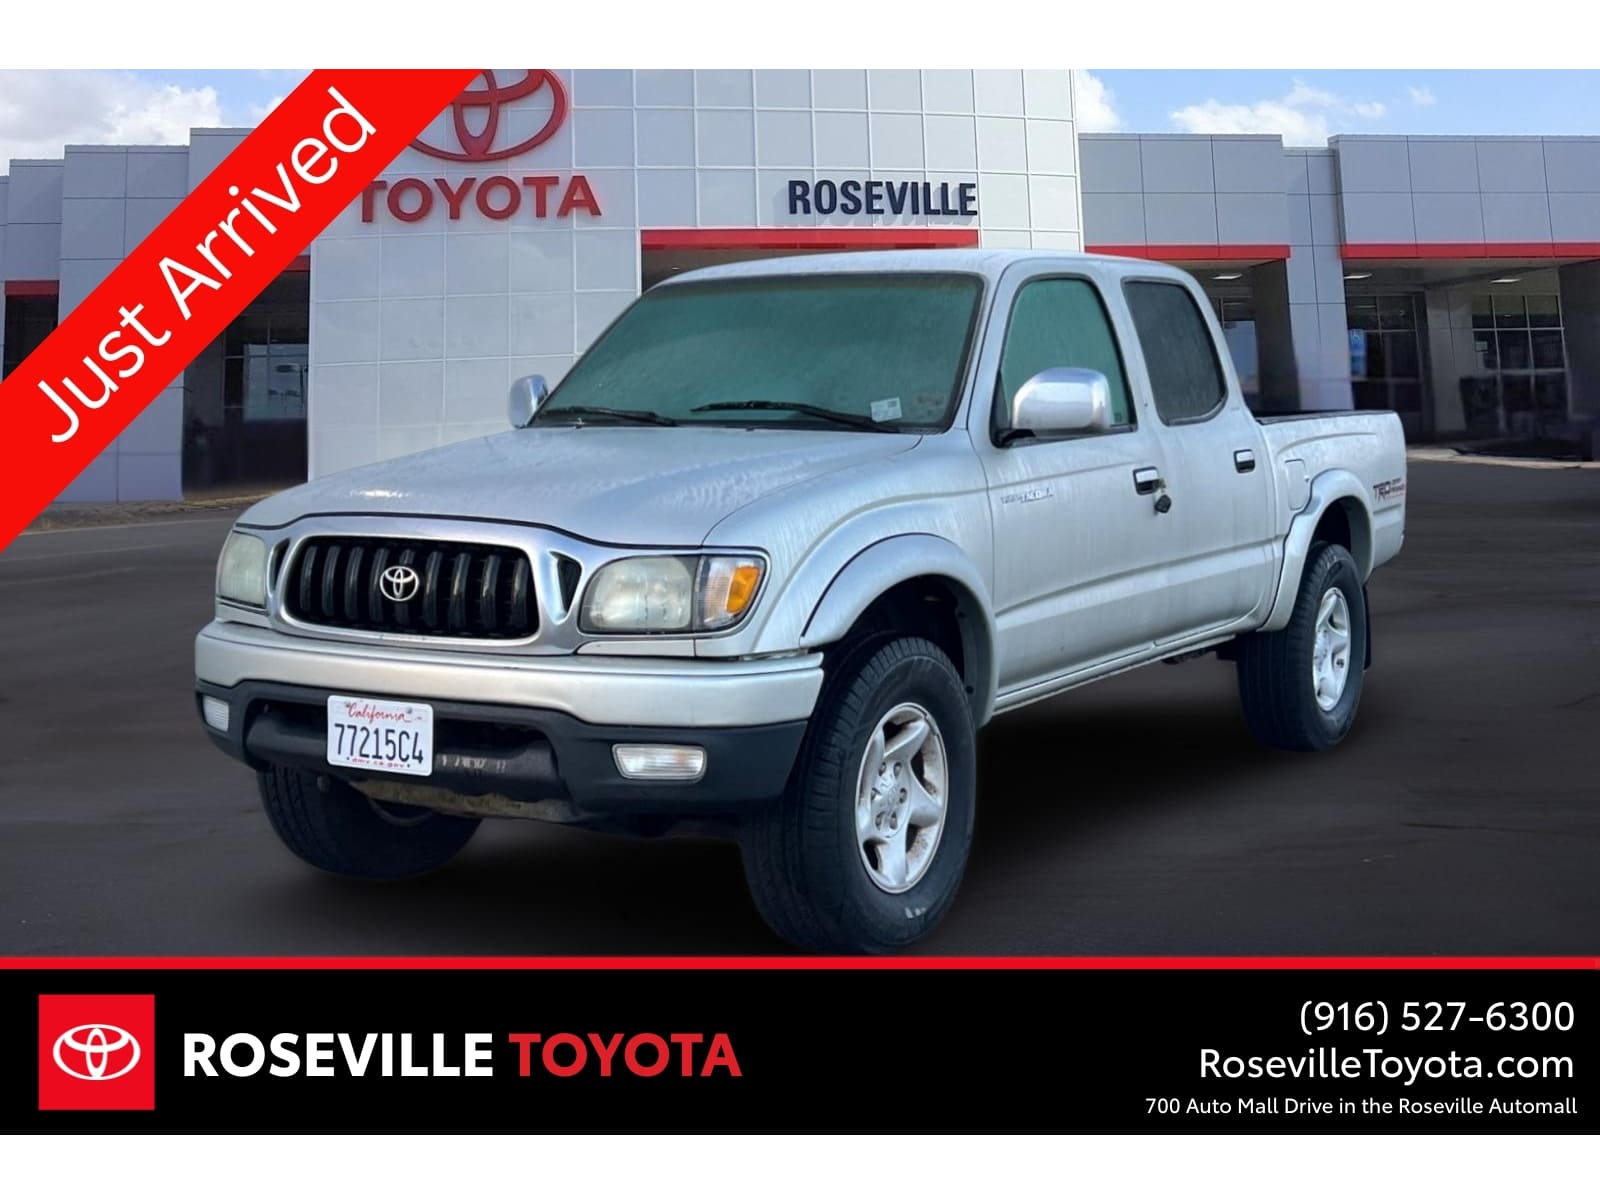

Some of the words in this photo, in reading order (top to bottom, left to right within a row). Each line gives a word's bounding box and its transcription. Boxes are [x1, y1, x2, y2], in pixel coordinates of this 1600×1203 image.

[361, 175, 602, 223] TOYOTA
[788, 180, 978, 216] ROSEVILLE
[348, 702, 412, 724] California
[334, 723, 424, 764] 77215C4
